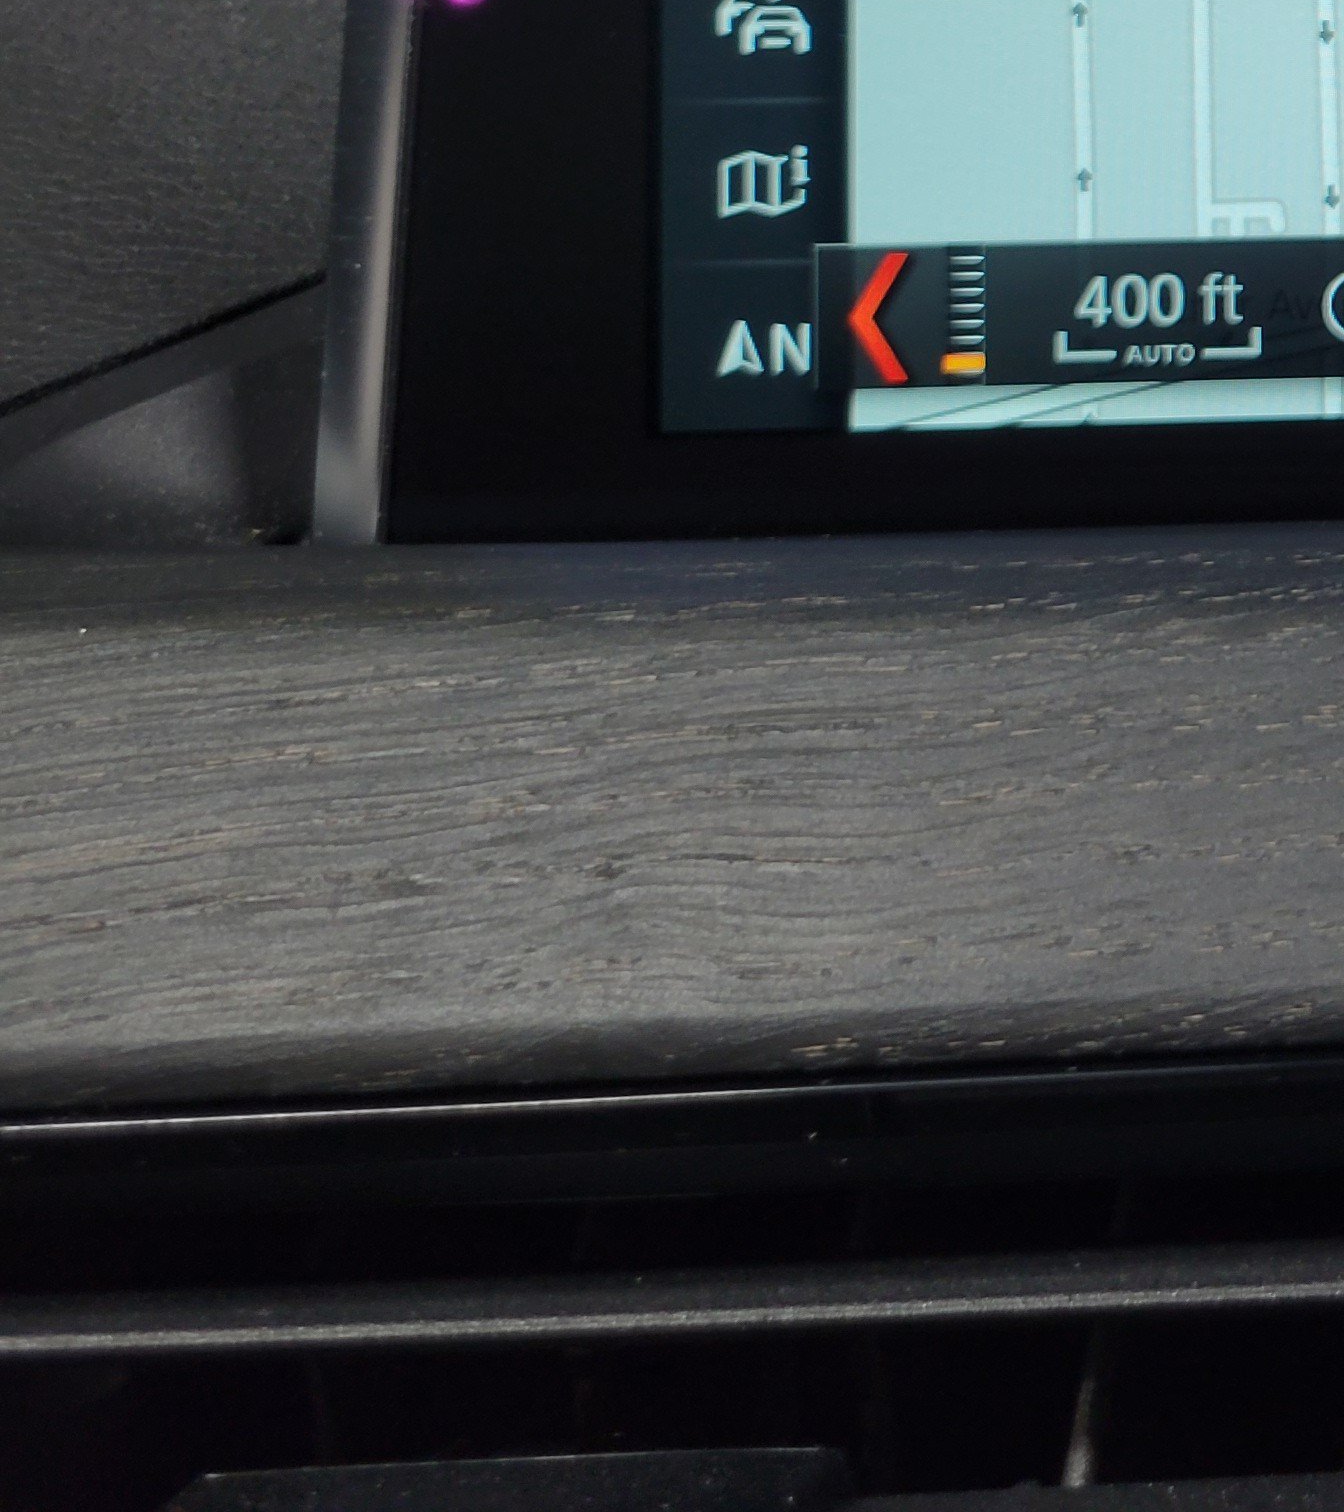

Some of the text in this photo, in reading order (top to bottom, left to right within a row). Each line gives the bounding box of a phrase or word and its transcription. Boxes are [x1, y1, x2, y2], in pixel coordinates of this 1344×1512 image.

[1074, 272, 1187, 329] 400
[1198, 270, 1245, 326] ft
[1121, 342, 1197, 368] AUTO
